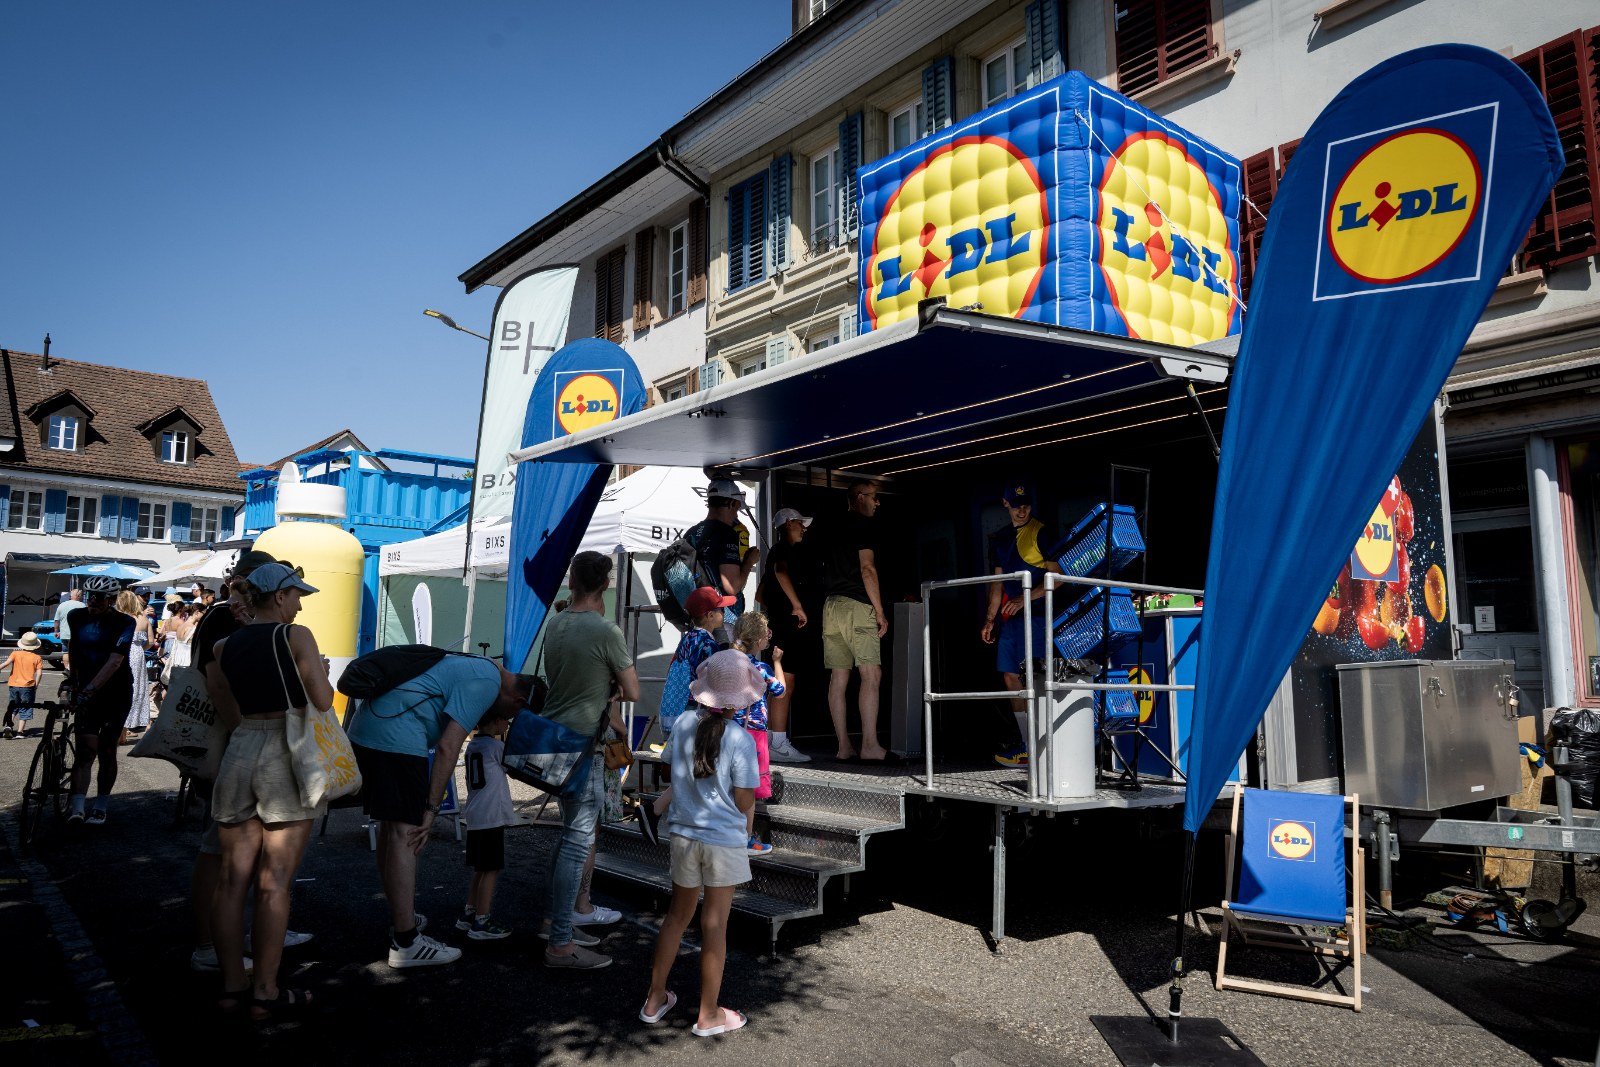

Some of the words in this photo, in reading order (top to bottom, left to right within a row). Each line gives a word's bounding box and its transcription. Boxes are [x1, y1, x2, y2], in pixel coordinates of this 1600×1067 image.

[481, 471, 516, 489] BIX
[651, 526, 684, 541] BIX
[485, 535, 505, 550] BIXS
[387, 551, 401, 562] BIXS
[175, 702, 215, 726] GRIND
